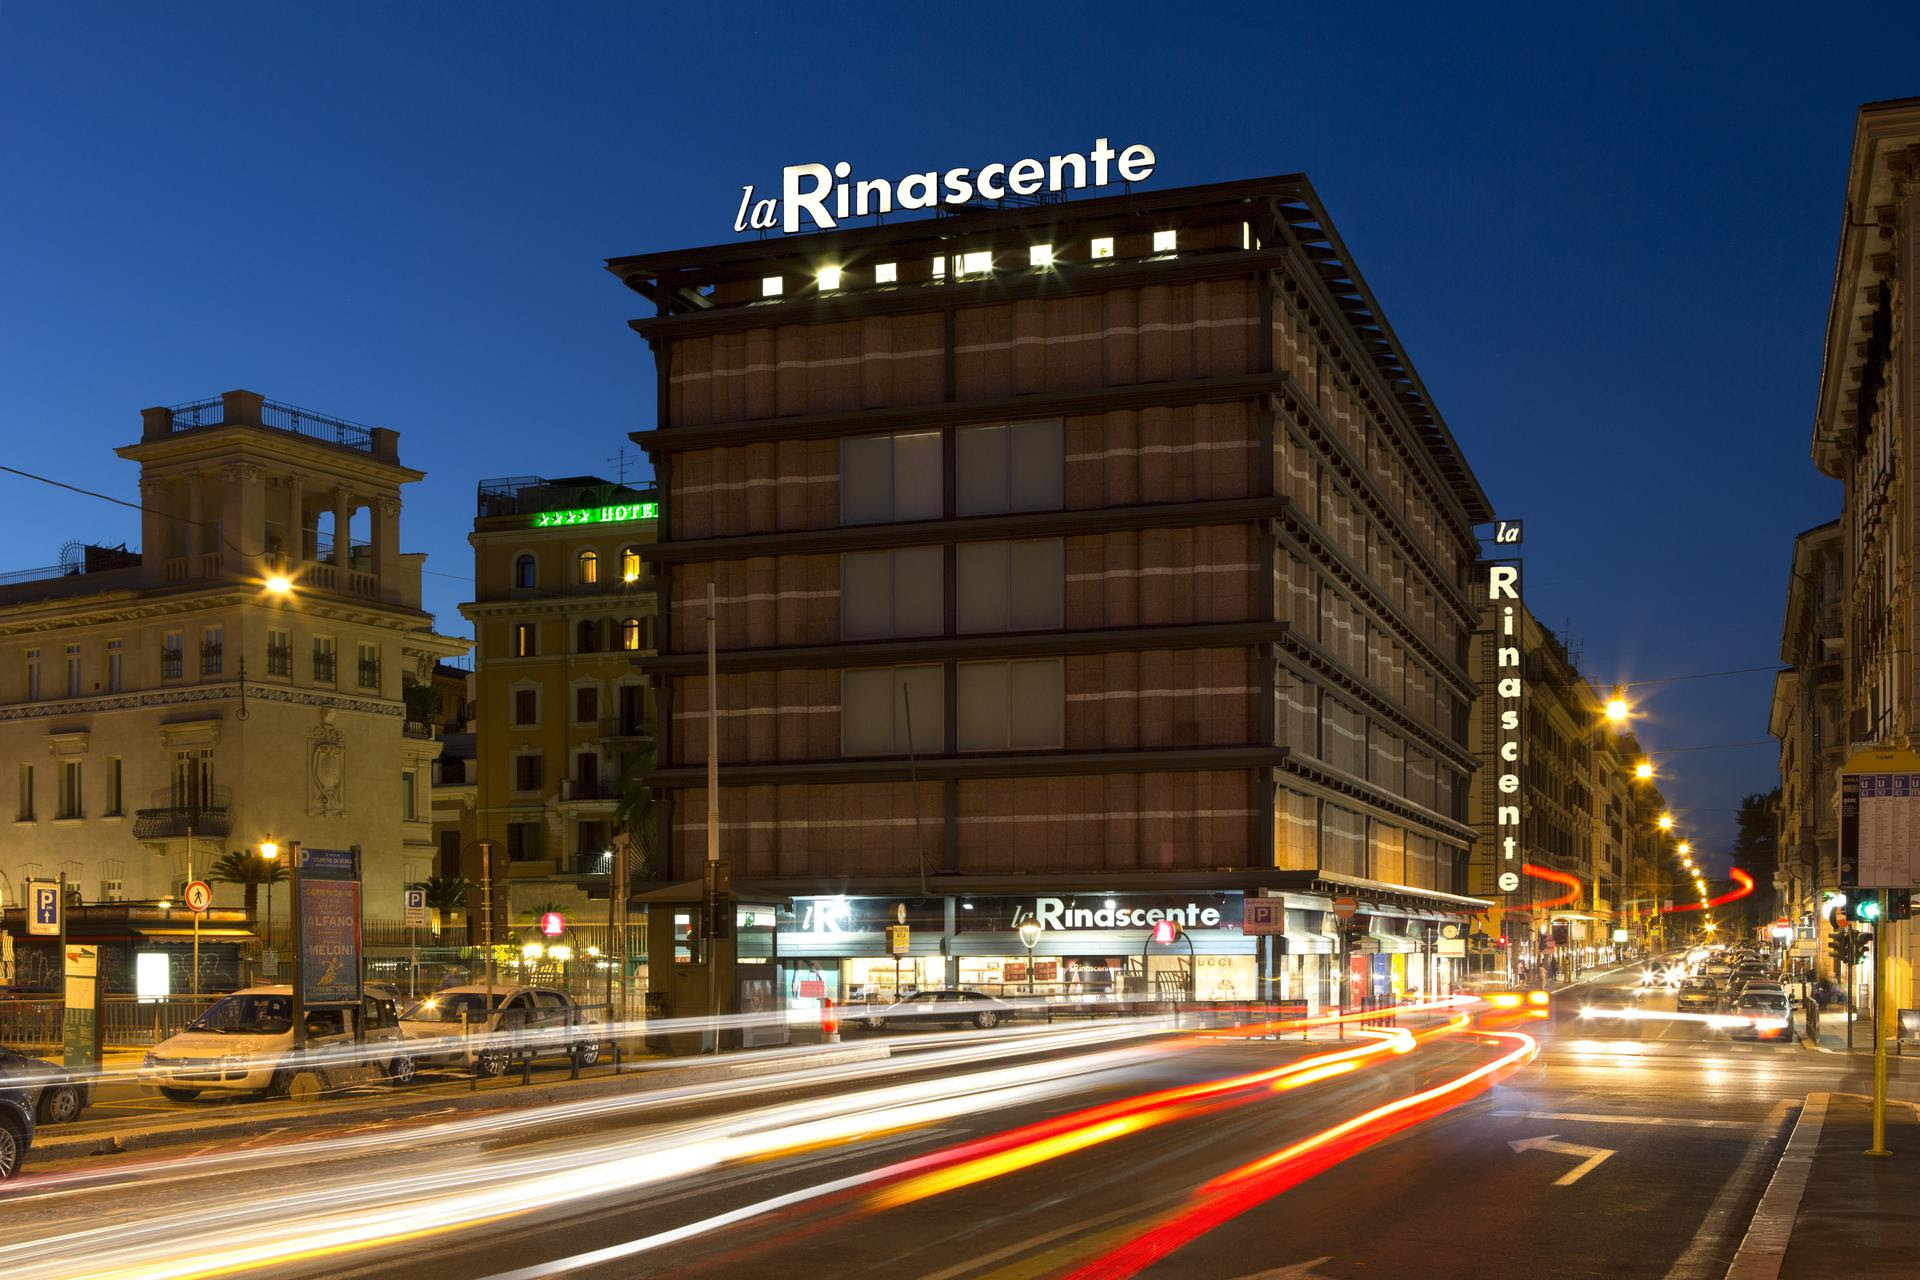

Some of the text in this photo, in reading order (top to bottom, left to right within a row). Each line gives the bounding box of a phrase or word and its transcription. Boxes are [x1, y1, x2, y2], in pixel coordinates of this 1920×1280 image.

[733, 137, 1156, 234] la Rinascente
[1496, 522, 1519, 543] la
[1489, 565, 1521, 892] Rinascente
[411, 893, 420, 906] P
[306, 915, 353, 927] ALFANO
[1036, 897, 1221, 931] Rinascente
[1257, 908, 1268, 922] P
[309, 944, 353, 956] MELONI
[1197, 958, 1232, 967] UCCI
